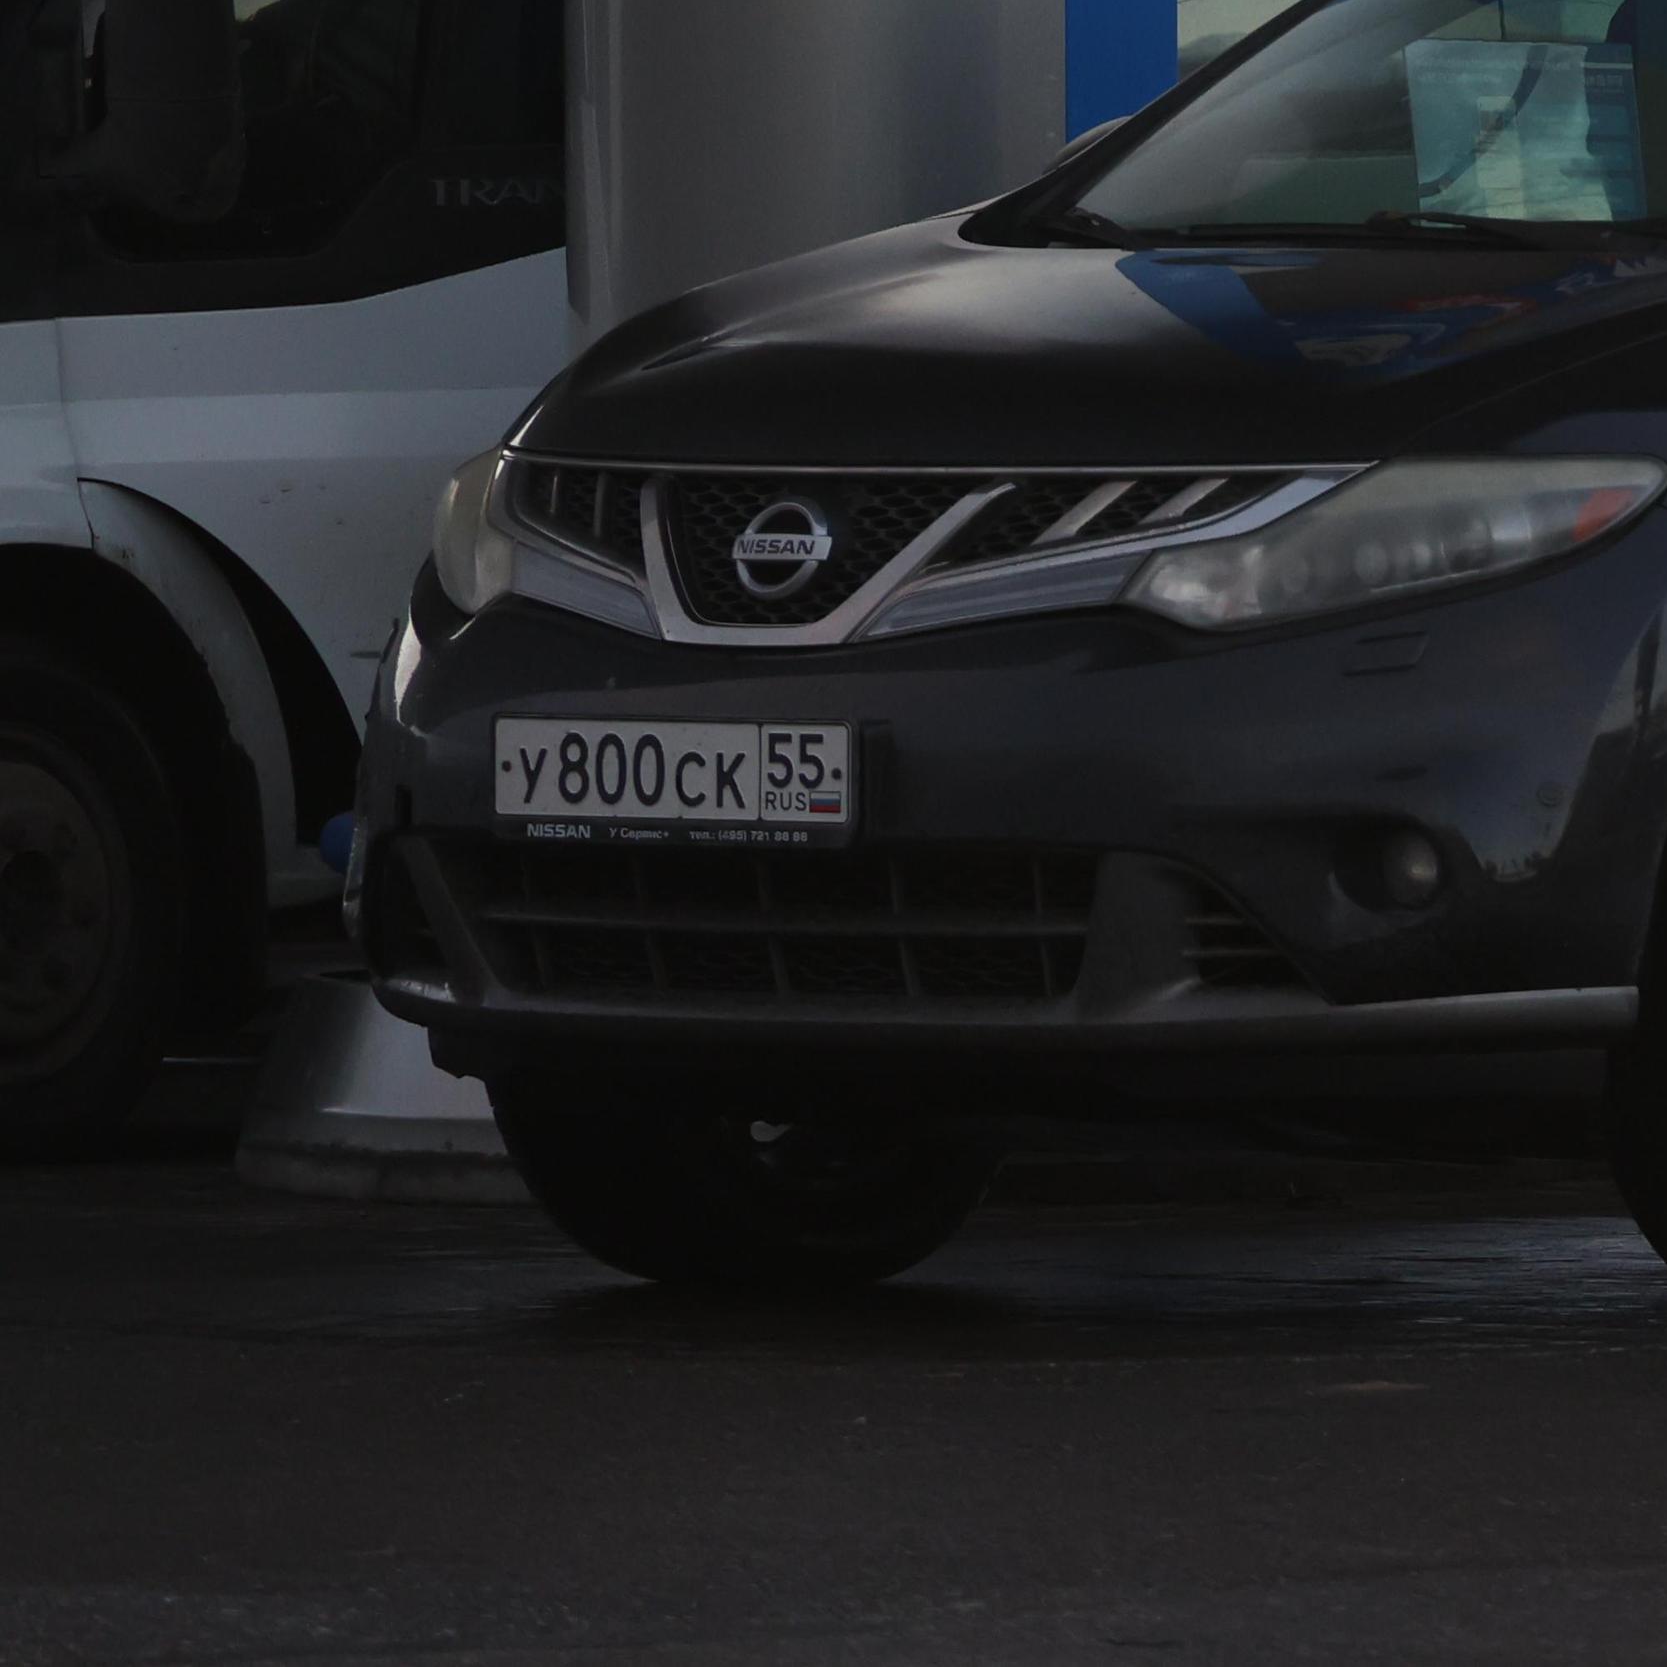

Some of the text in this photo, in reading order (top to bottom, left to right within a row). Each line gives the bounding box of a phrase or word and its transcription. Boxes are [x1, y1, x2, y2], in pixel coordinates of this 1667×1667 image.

[737, 538, 815, 555] NISSAN
[767, 733, 826, 789] 55
[765, 791, 807, 812] RUS
[526, 822, 591, 839] NISSAN
[750, 830, 770, 841] 721
